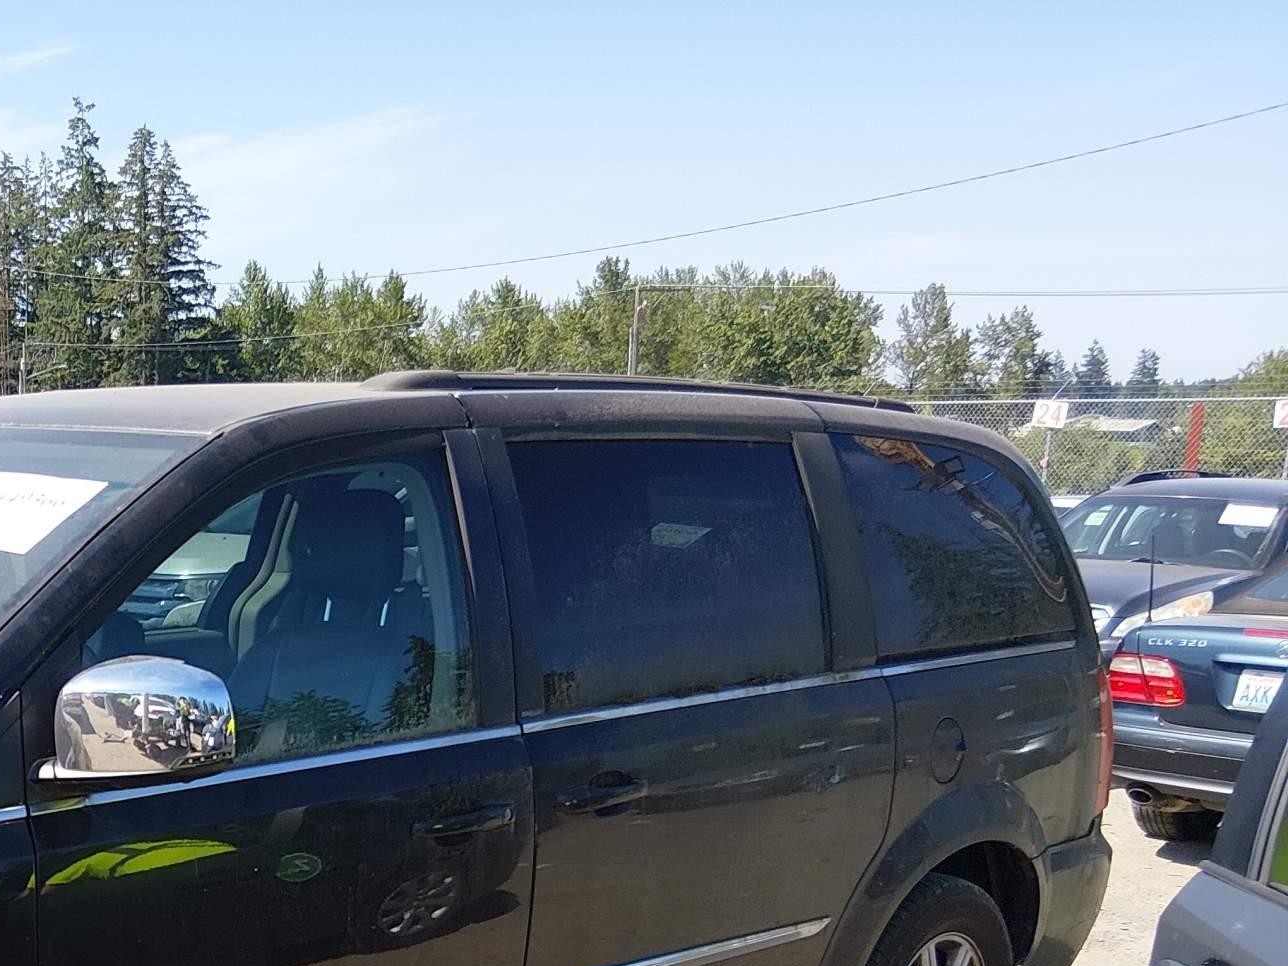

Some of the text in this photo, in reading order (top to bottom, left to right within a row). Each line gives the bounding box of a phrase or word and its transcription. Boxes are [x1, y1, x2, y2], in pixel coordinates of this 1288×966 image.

[1036, 403, 1062, 425] 24
[1148, 637, 1209, 647] CLK 320
